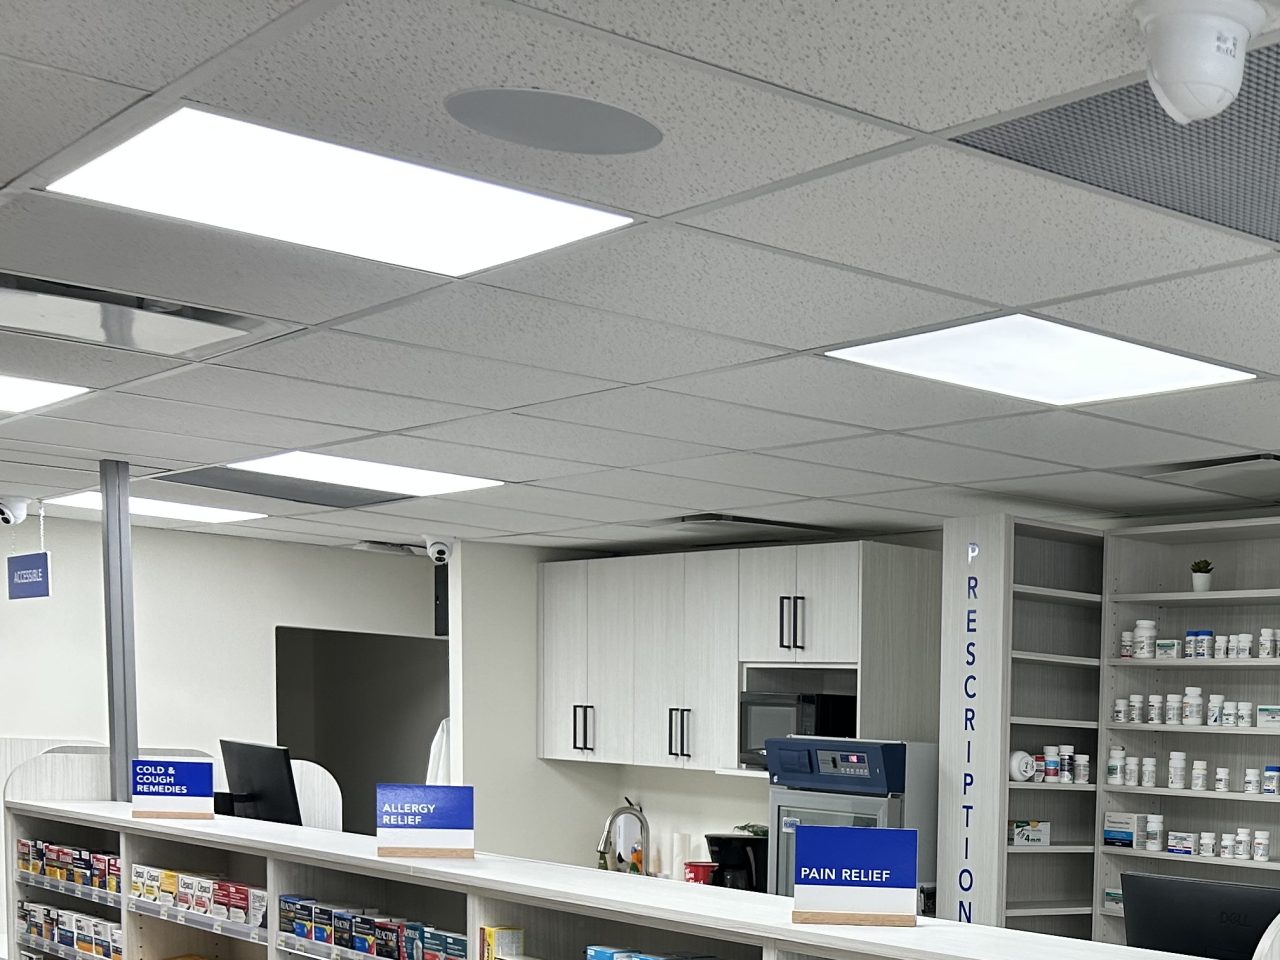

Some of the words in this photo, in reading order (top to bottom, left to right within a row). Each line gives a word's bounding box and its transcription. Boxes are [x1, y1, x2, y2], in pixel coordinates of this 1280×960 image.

[14, 568, 42, 584] ACCESSIBLE
[958, 542, 979, 924] PRESCRIPTION
[136, 766, 165, 775] COLD
[168, 766, 176, 775] &
[136, 775, 175, 784] COUGH
[136, 784, 188, 794] REMEDIES
[382, 803, 436, 814] ALLERGY
[382, 814, 423, 825] RELIEF
[801, 868, 836, 880] PAIN
[841, 869, 890, 882] RELIEF
